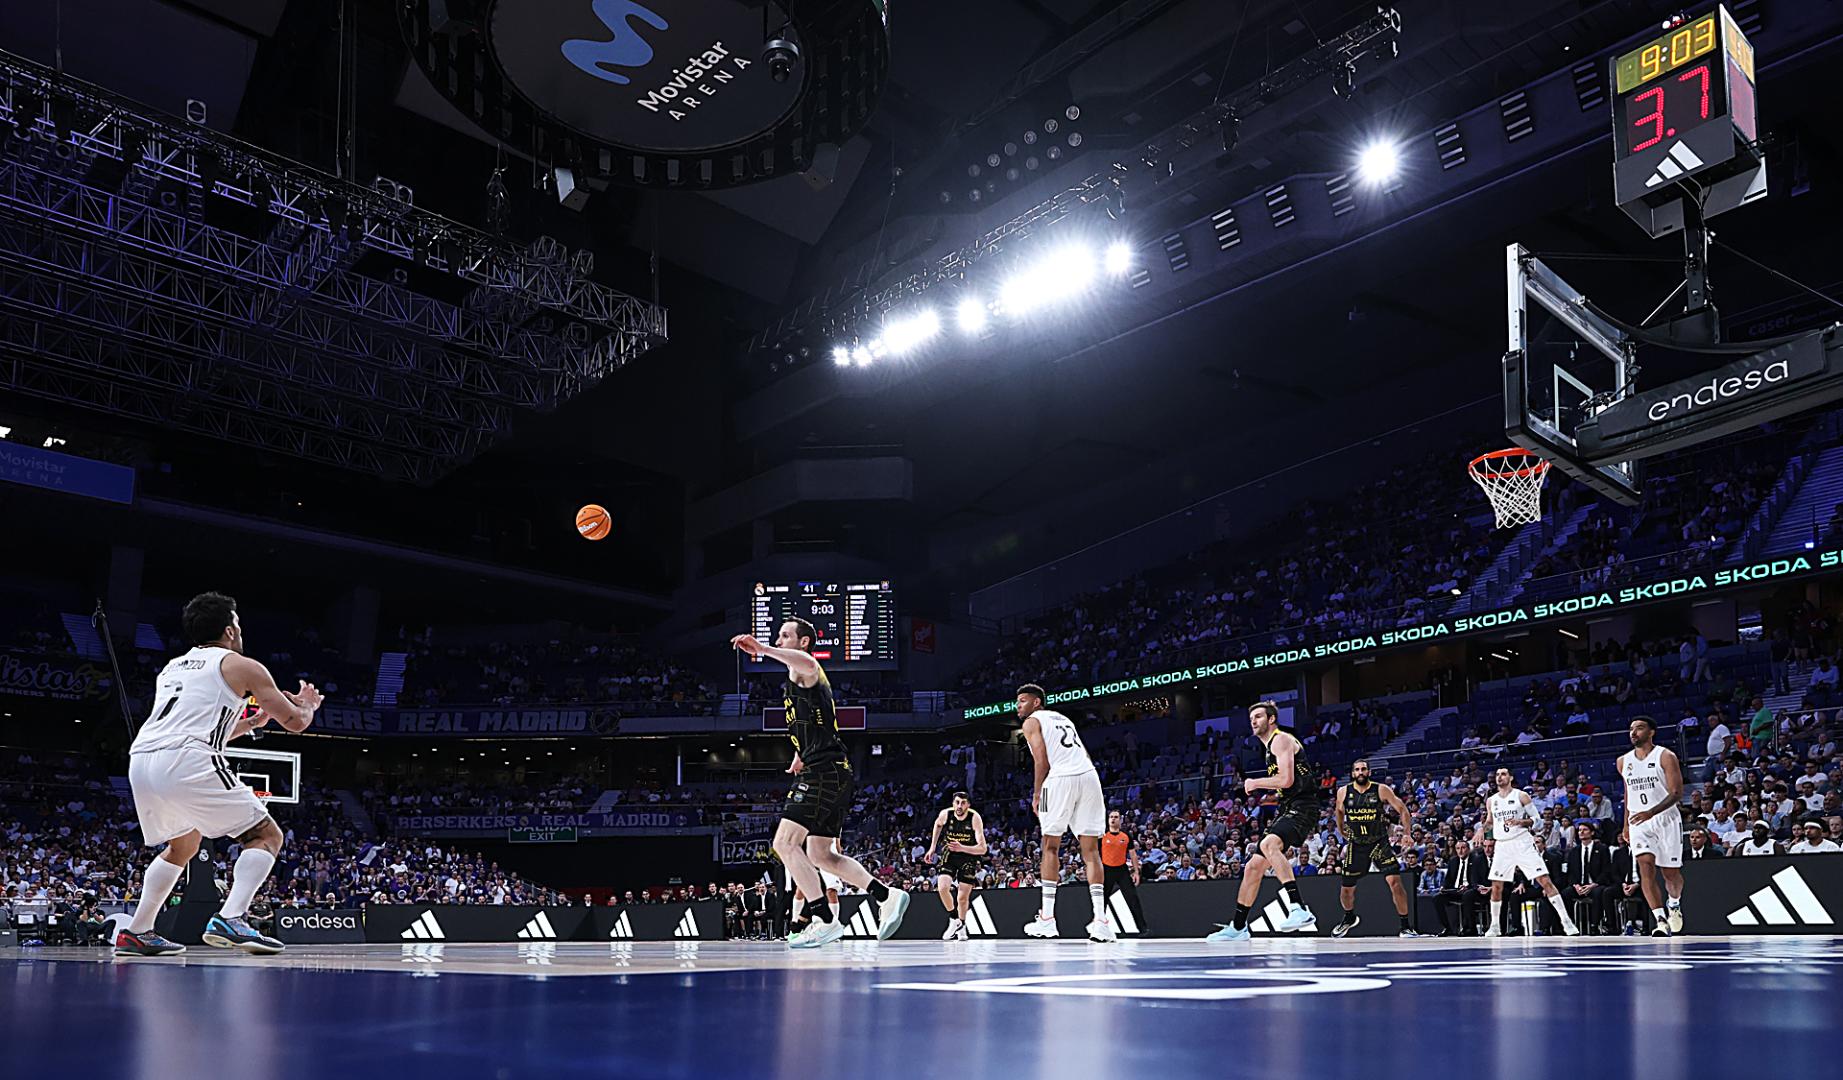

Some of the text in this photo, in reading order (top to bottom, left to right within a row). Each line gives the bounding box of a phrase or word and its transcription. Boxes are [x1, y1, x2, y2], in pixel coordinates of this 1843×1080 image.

[1641, 18, 1714, 81] 9:03
[637, 41, 729, 112] Movistar
[668, 57, 752, 121] ARENA
[1633, 65, 1710, 152] 3.7
[1648, 360, 1789, 421] endesa
[826, 584, 838, 593] 47
[811, 604, 834, 615] 9:03
[1046, 688, 1090, 705] SKODA
[1092, 679, 1139, 697] SKODA
[1142, 669, 1193, 688] SKODA
[1196, 658, 1250, 678] SKODA
[1253, 648, 1311, 668] SKODA
[1314, 635, 1377, 658] SKODA
[1381, 622, 1449, 646] SKODA
[1454, 608, 1528, 633] SKODA
[1534, 592, 1613, 618] SKODA
[1619, 576, 1707, 603] SKODA
[1714, 556, 1811, 586] SKODA
[399, 711, 469, 732] REAL
[478, 710, 587, 732] MADRID
[1626, 775, 1660, 787] Emirates
[1640, 793, 1648, 805] 0
[399, 813, 670, 829] BERSERKERS REAL MADRID
[529, 832, 555, 841] EXIT
[280, 913, 356, 929] endesa
